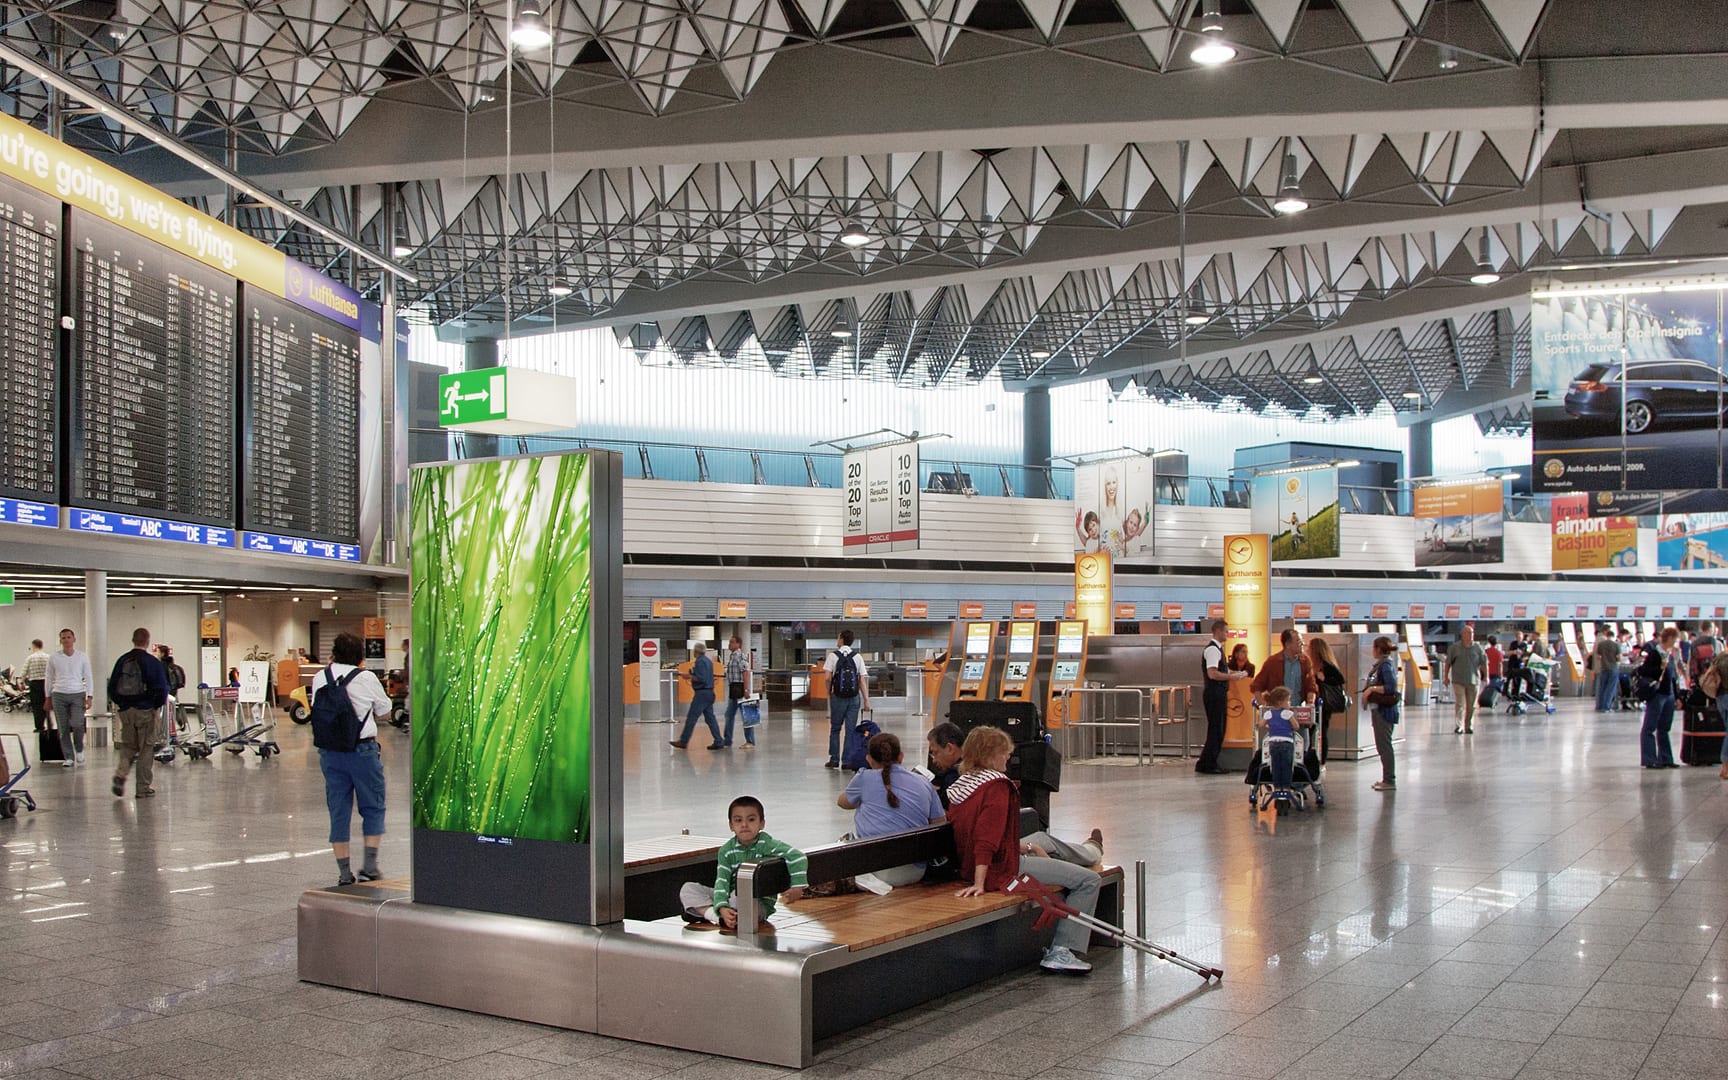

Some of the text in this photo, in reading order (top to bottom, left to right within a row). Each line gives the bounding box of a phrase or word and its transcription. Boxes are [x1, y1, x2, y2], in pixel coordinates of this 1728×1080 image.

[0, 132, 238, 268] u're going, we're flying.
[308, 281, 358, 320] Lufthansa
[1544, 331, 1596, 342] Entdecke
[1626, 326, 1656, 341] Opel
[1658, 325, 1703, 340] Insignia
[1544, 343, 1580, 356] Sports
[848, 462, 861, 478] 20
[898, 454, 911, 470] 10
[1585, 464, 1597, 472] des
[1598, 463, 1621, 472] Jahres
[1626, 463, 1646, 471] 2009.
[848, 488, 861, 503] 20
[870, 488, 888, 496] Results
[898, 480, 911, 495] 10
[899, 497, 911, 508] Top
[1557, 503, 1586, 517] frank
[849, 506, 861, 517] Top
[140, 521, 162, 538] ABC
[186, 526, 200, 542] DE
[1556, 516, 1608, 537] airport
[292, 540, 308, 554] ABC
[325, 544, 335, 557] DE
[1556, 534, 1606, 551] casino
